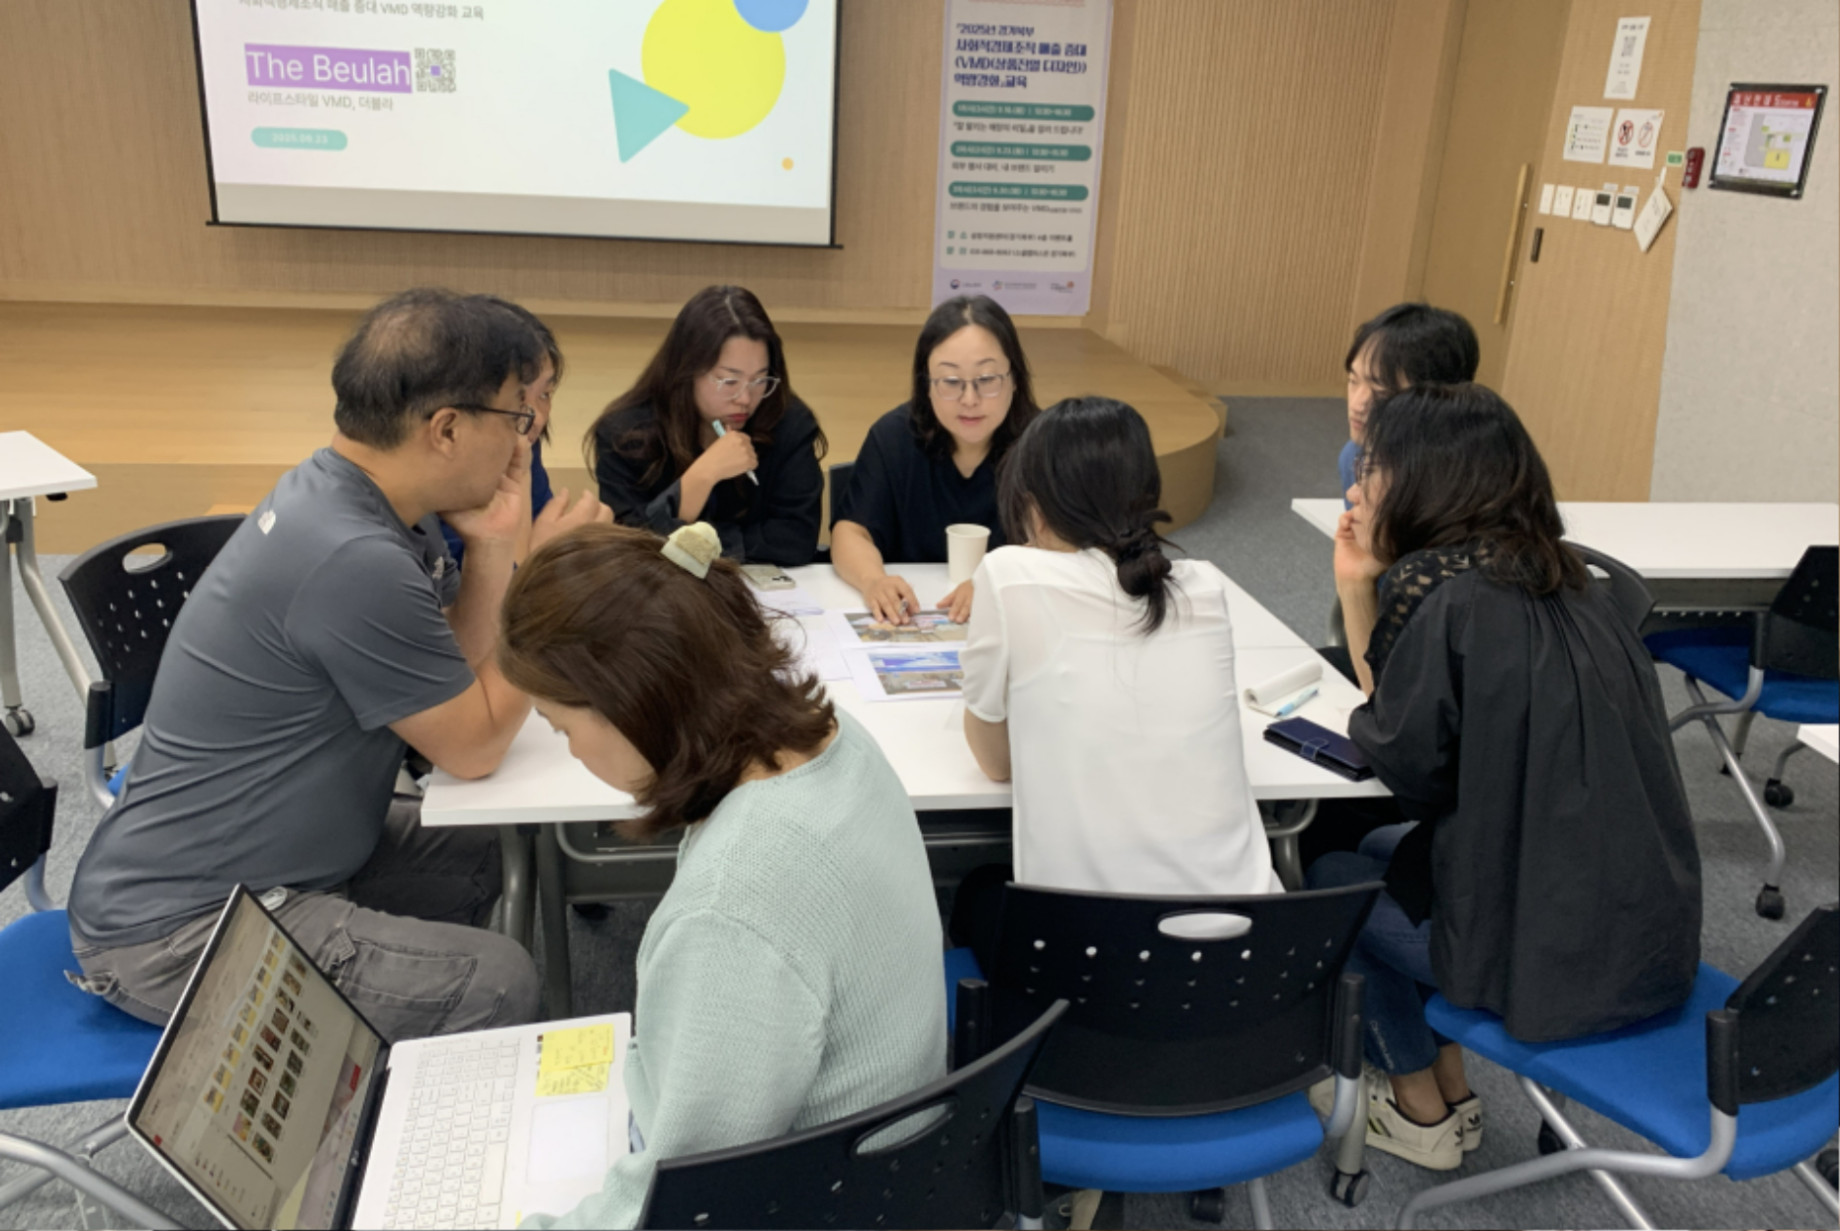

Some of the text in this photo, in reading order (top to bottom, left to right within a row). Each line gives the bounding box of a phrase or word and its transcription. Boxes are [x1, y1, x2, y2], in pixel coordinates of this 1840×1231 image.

[380, 3, 408, 15] VMD
[411, 3, 458, 18] 역량강화
[462, 5, 484, 20] 교육
[956, 38, 1036, 55] 사회적경제조직
[246, 51, 410, 86] The Beulah
[248, 90, 393, 111] 라이프스타일 VMD, 더블라
